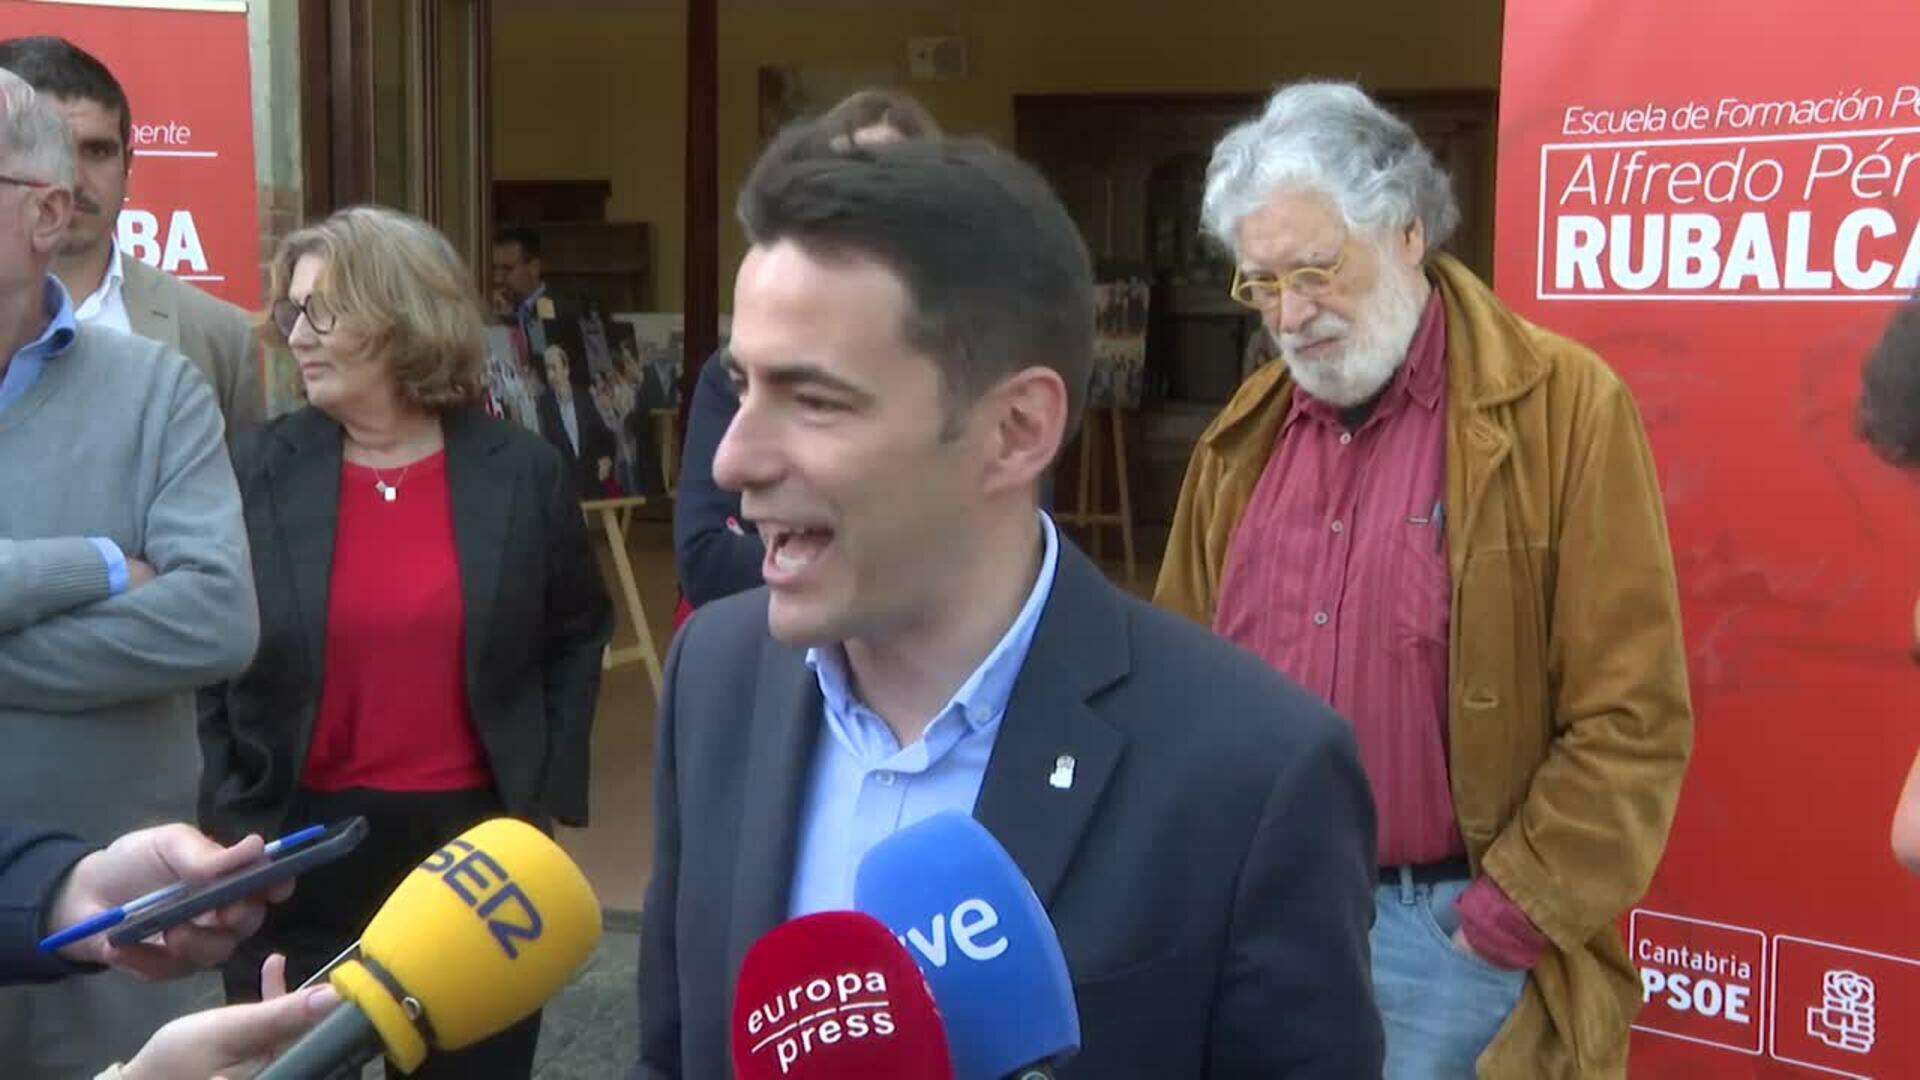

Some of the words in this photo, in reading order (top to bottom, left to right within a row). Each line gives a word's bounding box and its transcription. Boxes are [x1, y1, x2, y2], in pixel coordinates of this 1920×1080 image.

[1562, 104, 1666, 135] Escuela
[1672, 102, 1709, 130] de
[1714, 90, 1884, 128] Formación
[1559, 148, 1784, 205] Alfredo
[1638, 938, 1751, 980] Cantabria
[747, 971, 887, 1034] europa
[1640, 967, 1751, 1024] PSOE
[776, 1011, 896, 1074] press
